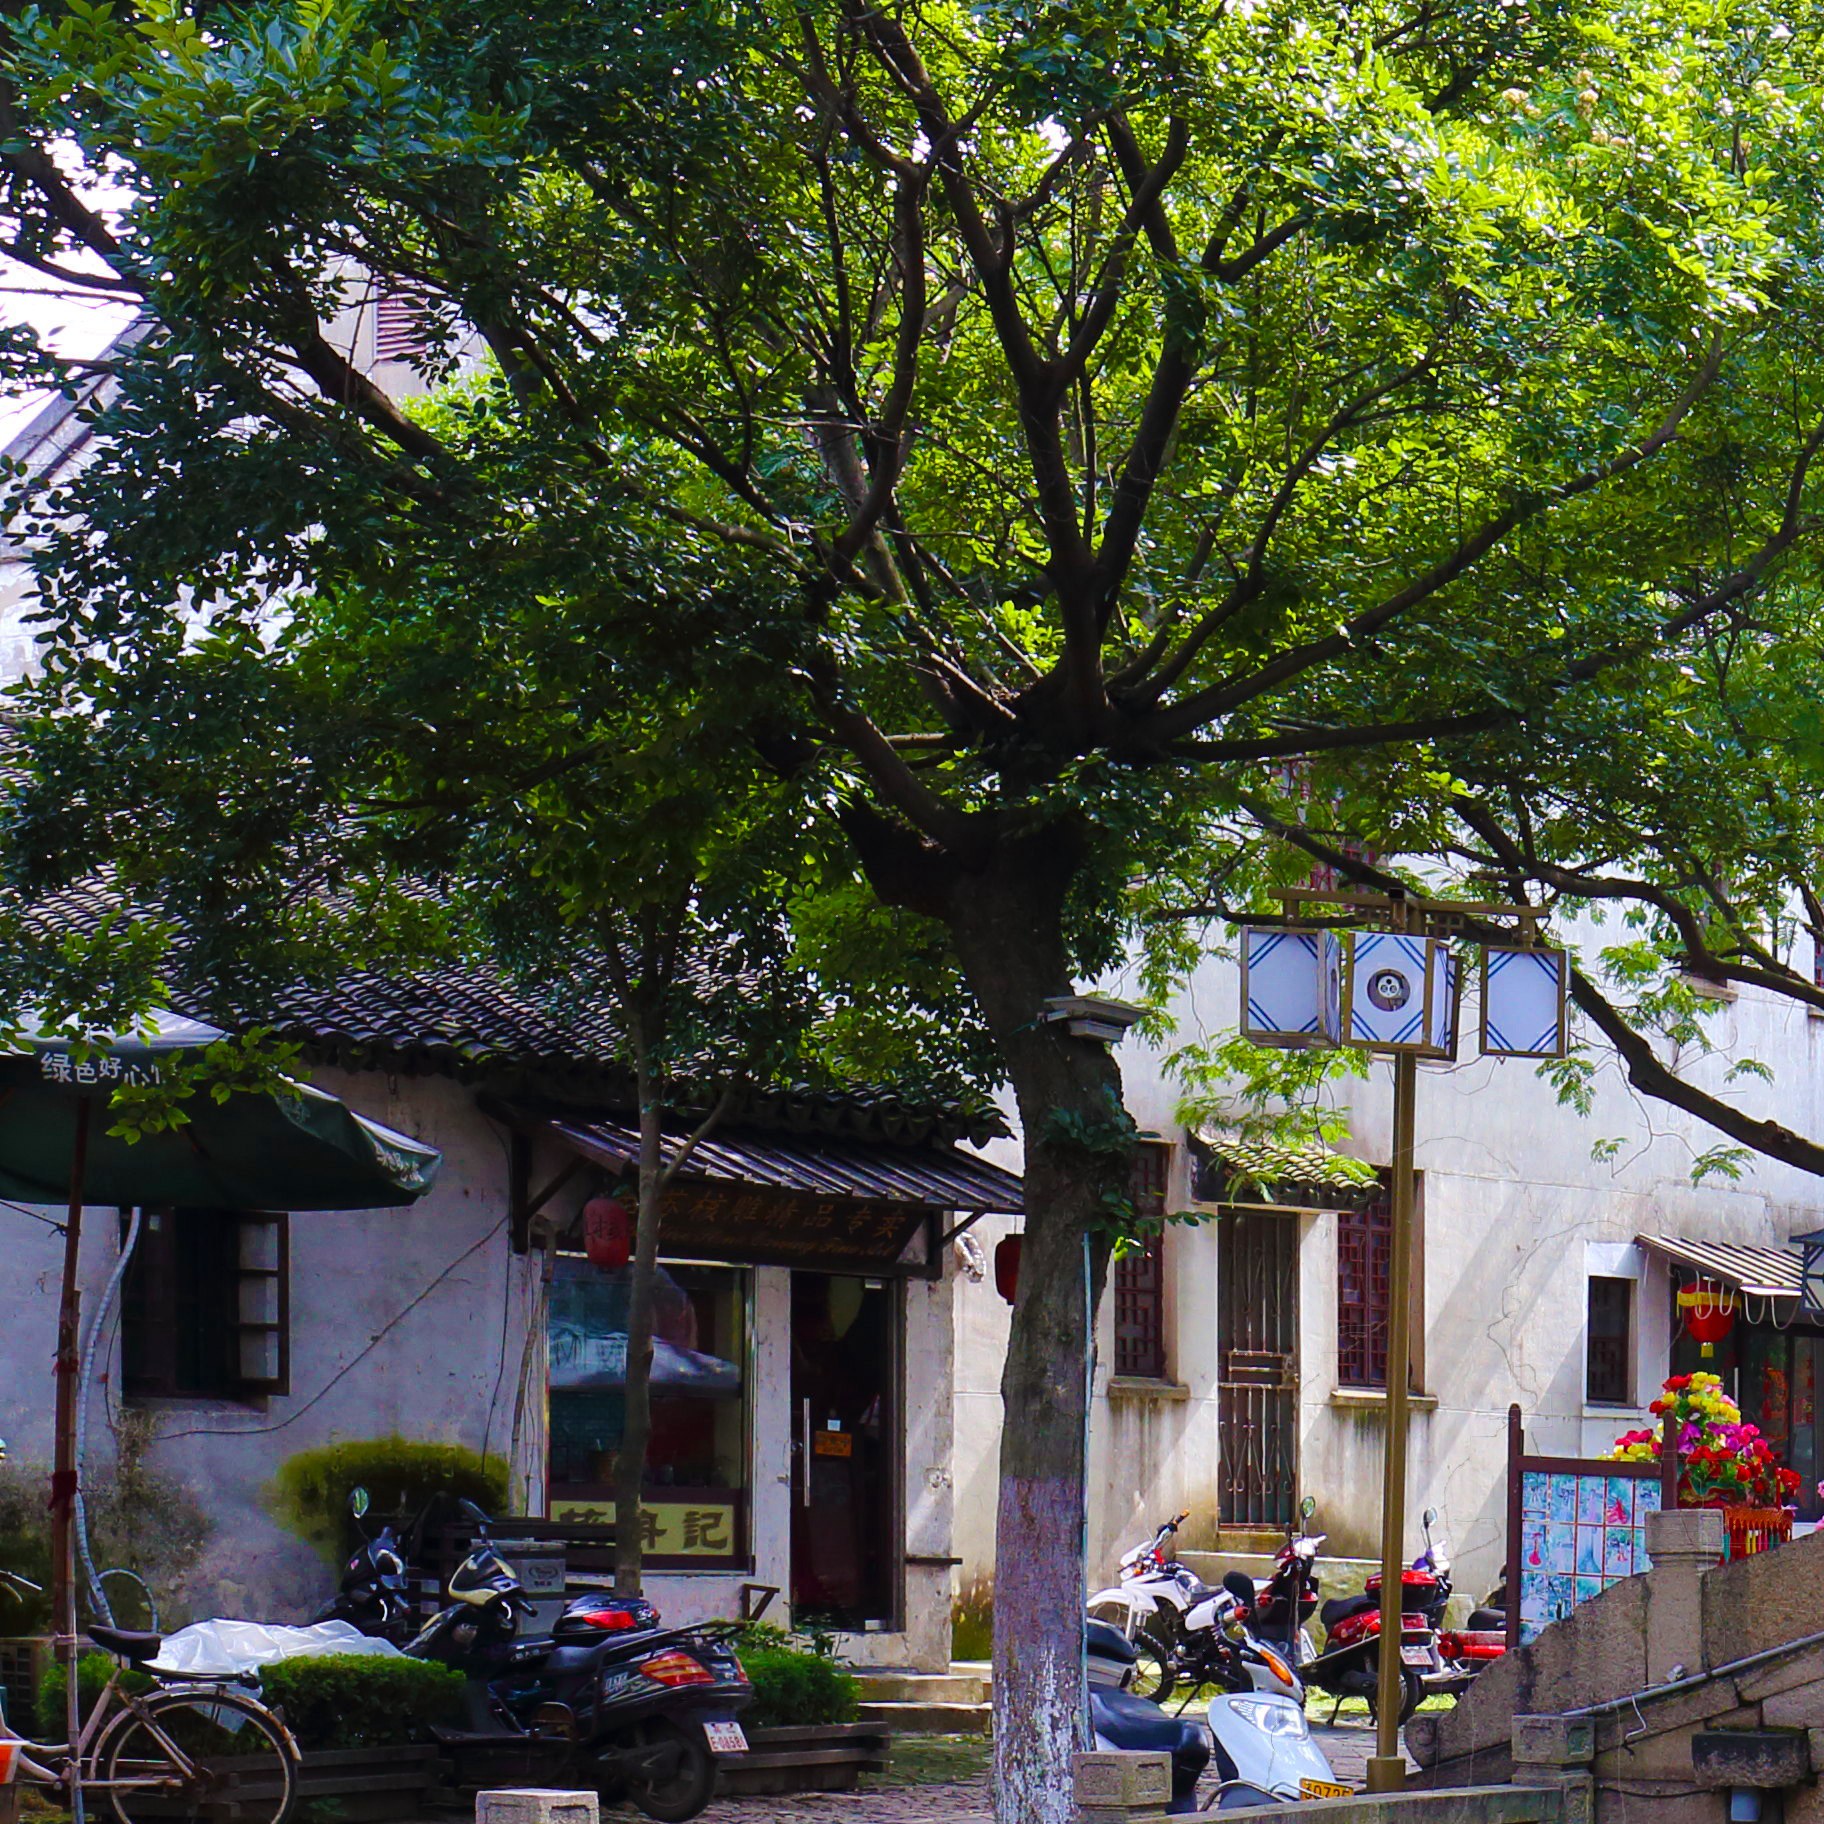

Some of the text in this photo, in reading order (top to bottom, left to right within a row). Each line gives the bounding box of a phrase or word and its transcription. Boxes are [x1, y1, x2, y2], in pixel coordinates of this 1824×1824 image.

[620, 1188, 908, 1240] 苏核雕精品专卖
